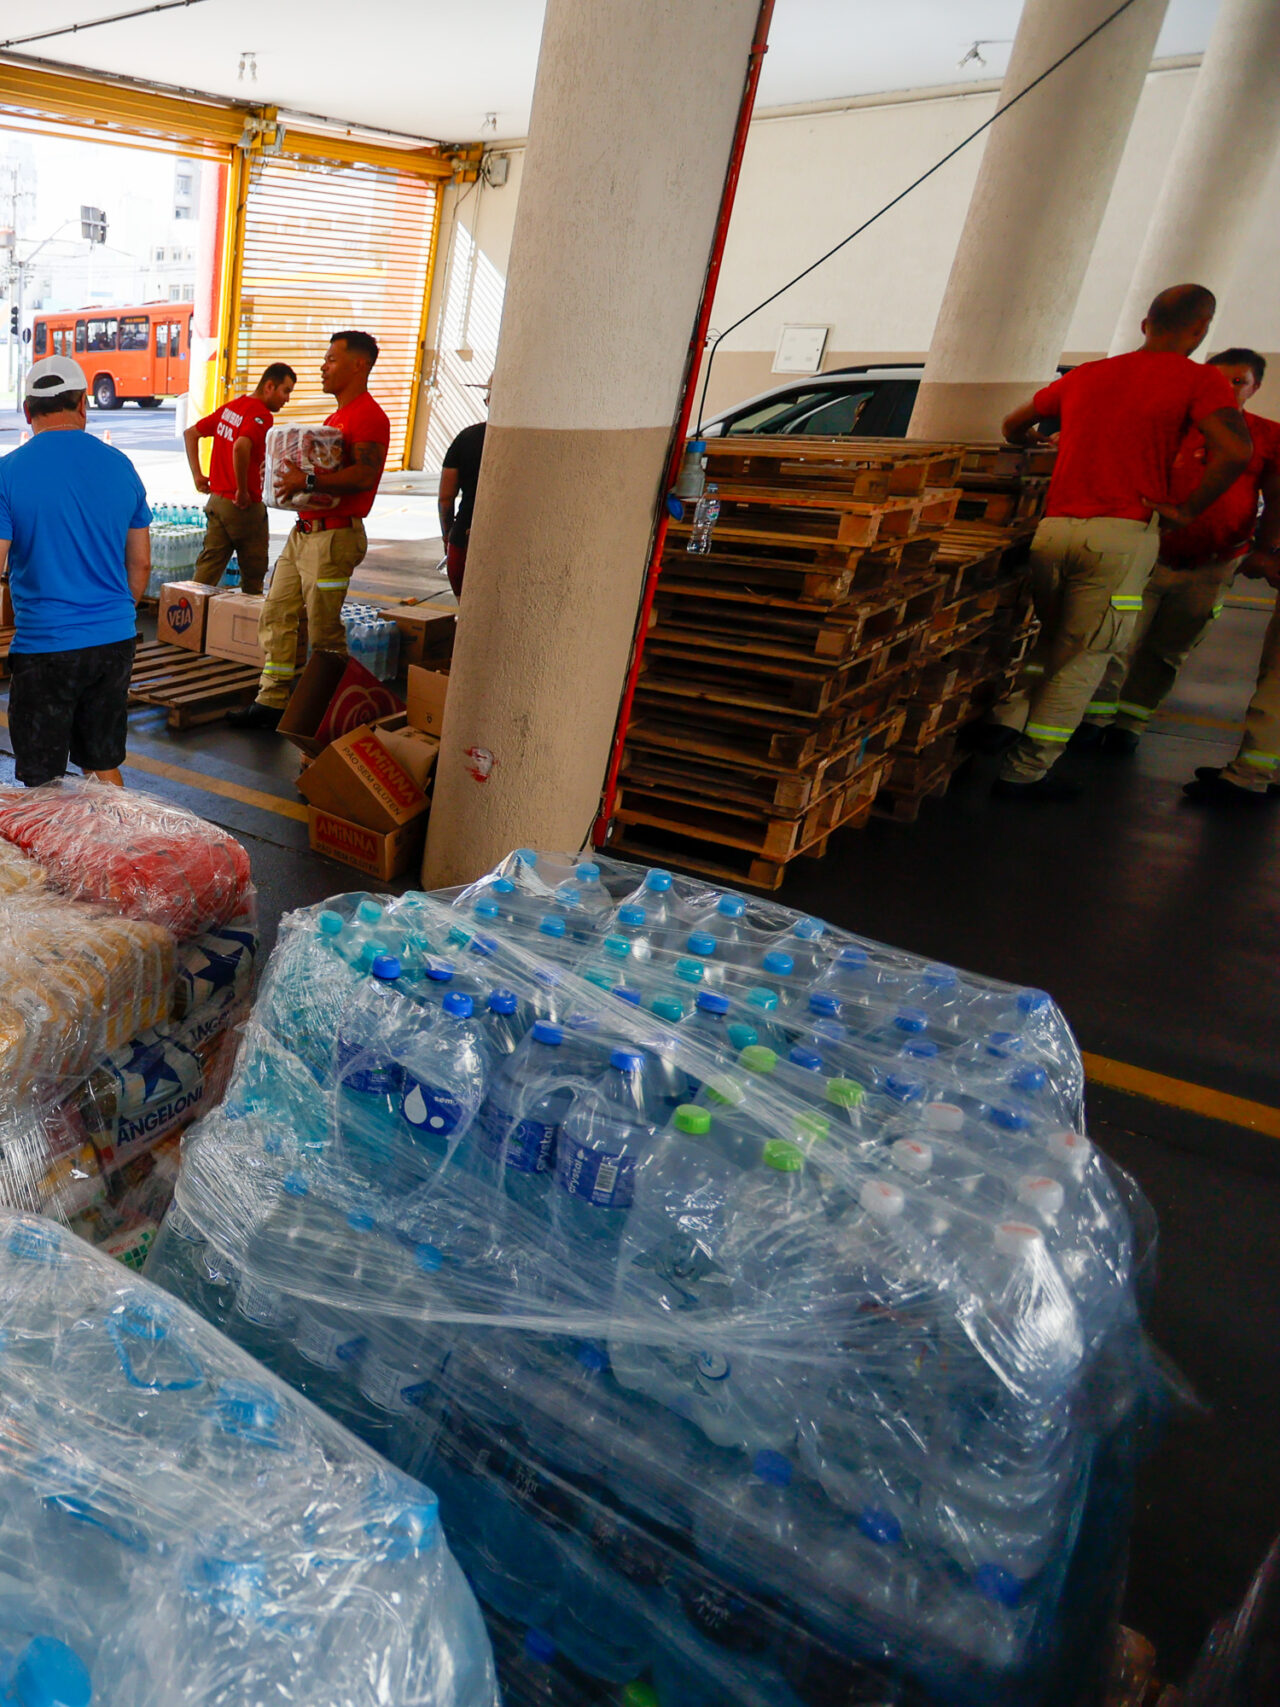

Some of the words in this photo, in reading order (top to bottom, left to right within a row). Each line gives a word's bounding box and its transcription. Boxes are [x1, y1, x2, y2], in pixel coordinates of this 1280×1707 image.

[168, 608, 192, 627] VEJA
[358, 764, 374, 784] SEM
[117, 1086, 203, 1148] ANGELONI
[568, 1159, 584, 1194] crystal
